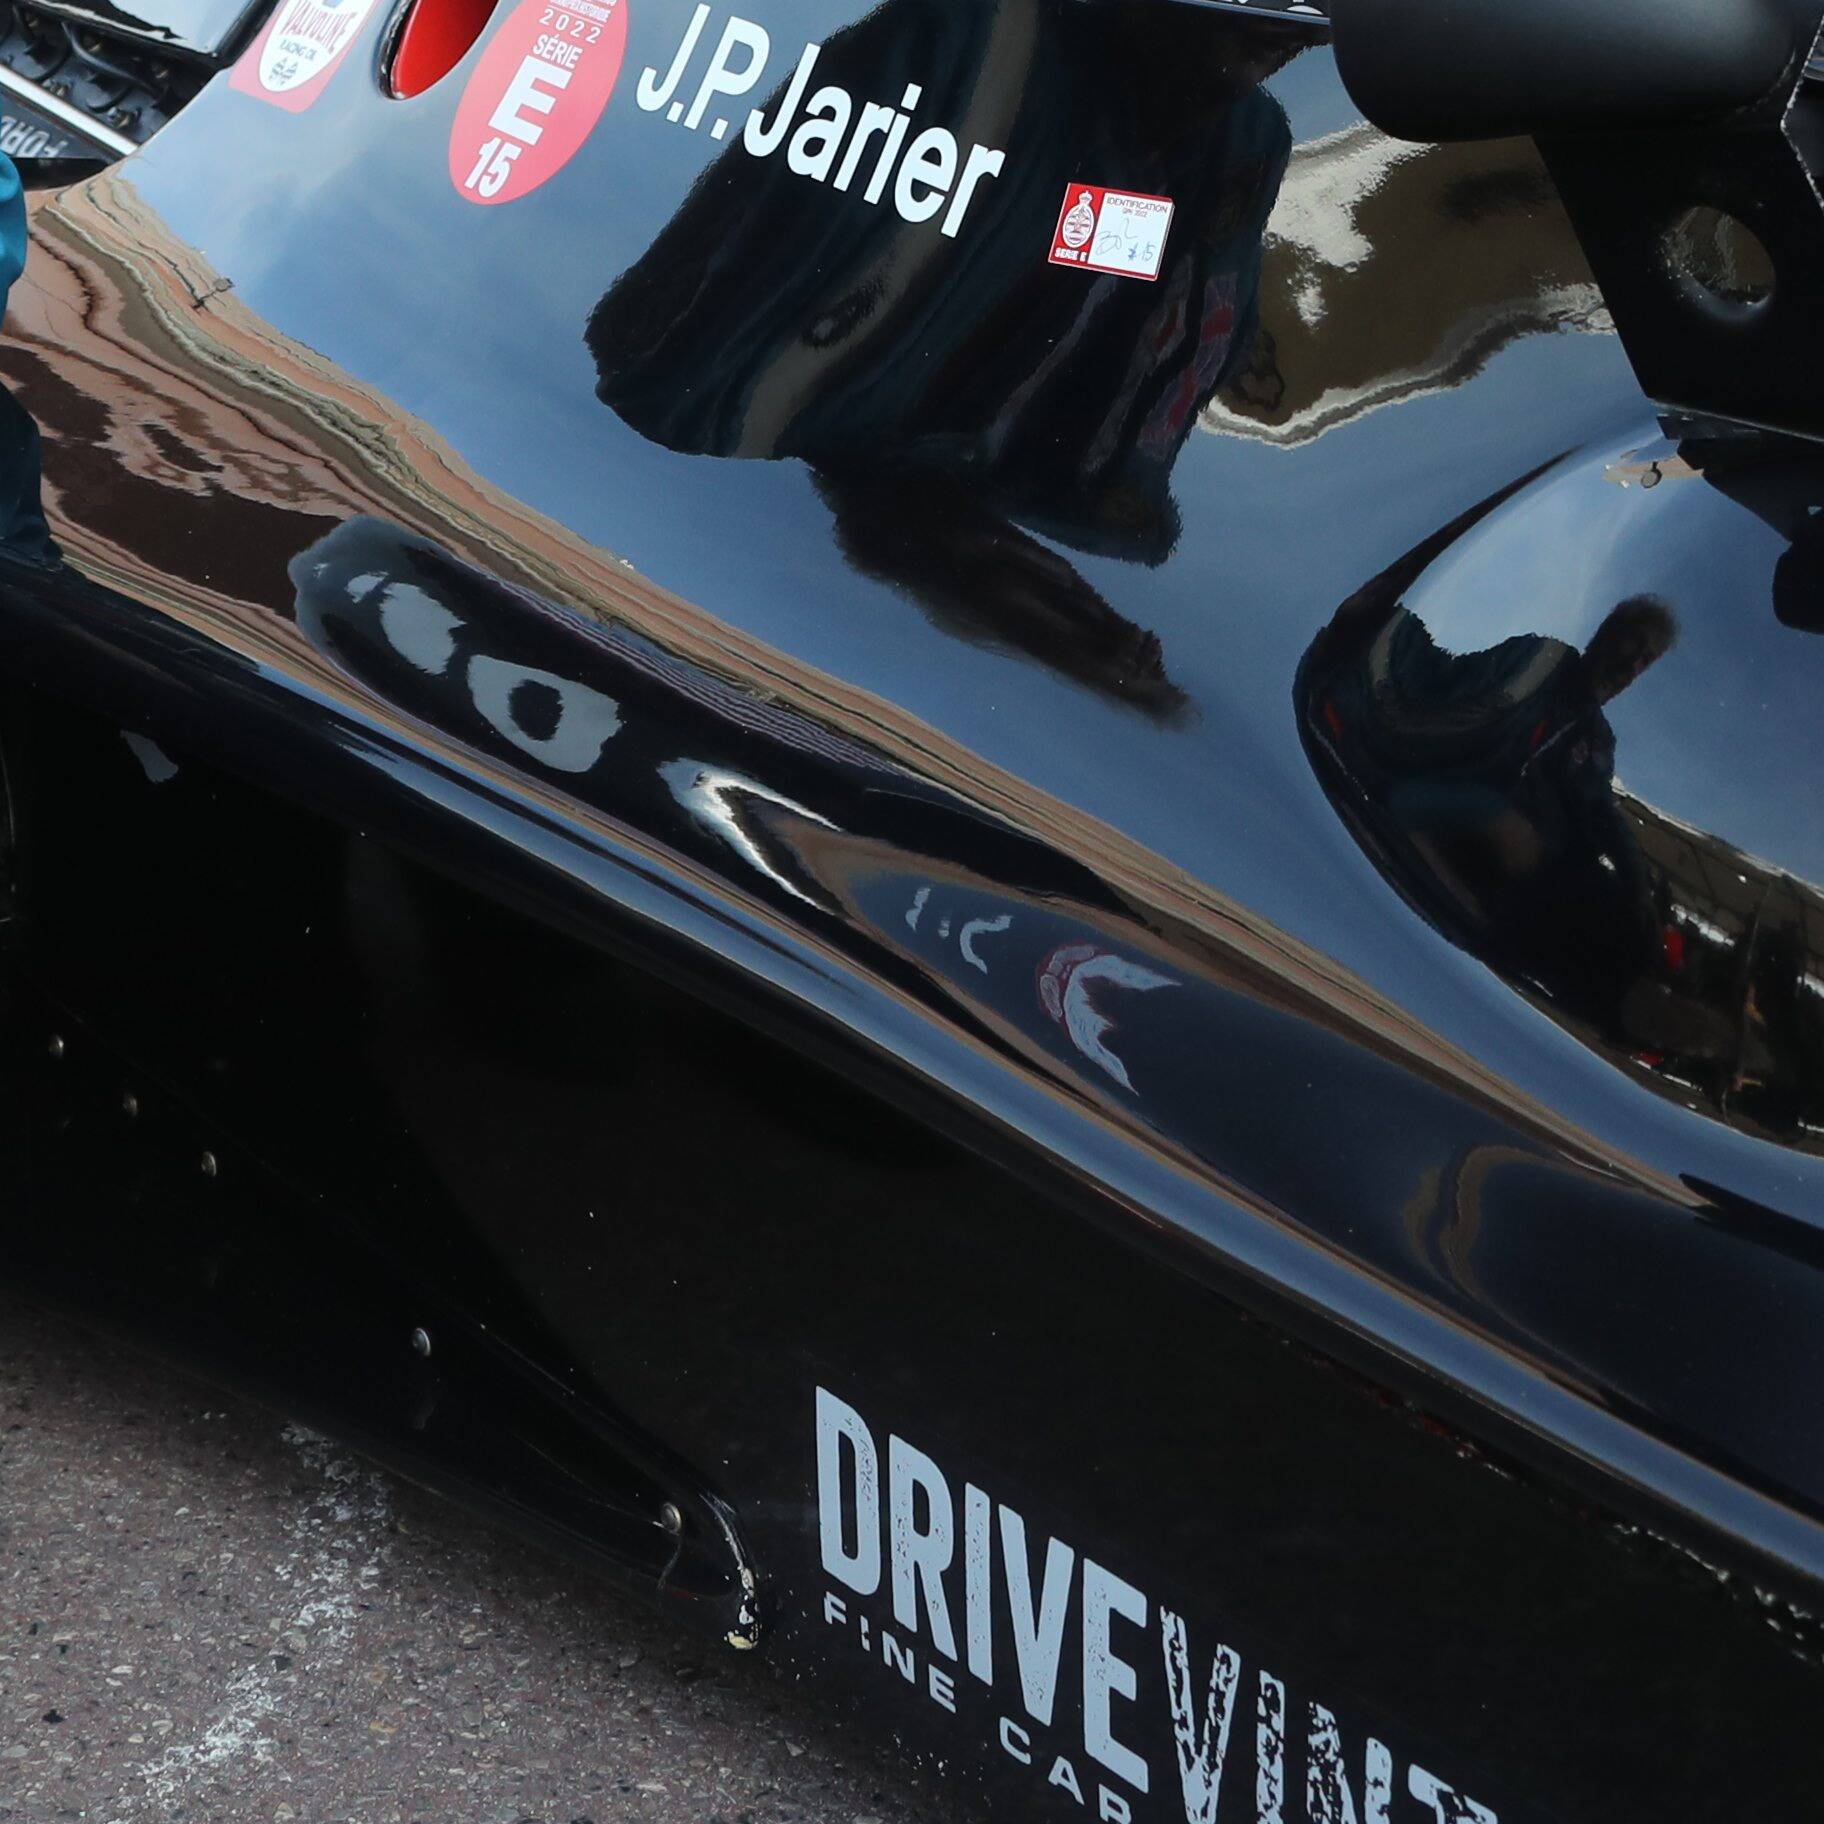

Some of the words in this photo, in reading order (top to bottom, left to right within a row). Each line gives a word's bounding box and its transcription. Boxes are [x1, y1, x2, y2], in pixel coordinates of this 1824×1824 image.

[538, 8, 602, 44] 2022
[532, 33, 584, 69] SÉRIE
[487, 54, 573, 147] E
[464, 136, 522, 198] 15
[1106, 196, 1168, 213] IDENTIFICATION
[824, 1591, 957, 1715] FINE
[998, 1716, 1134, 1824] CAR
